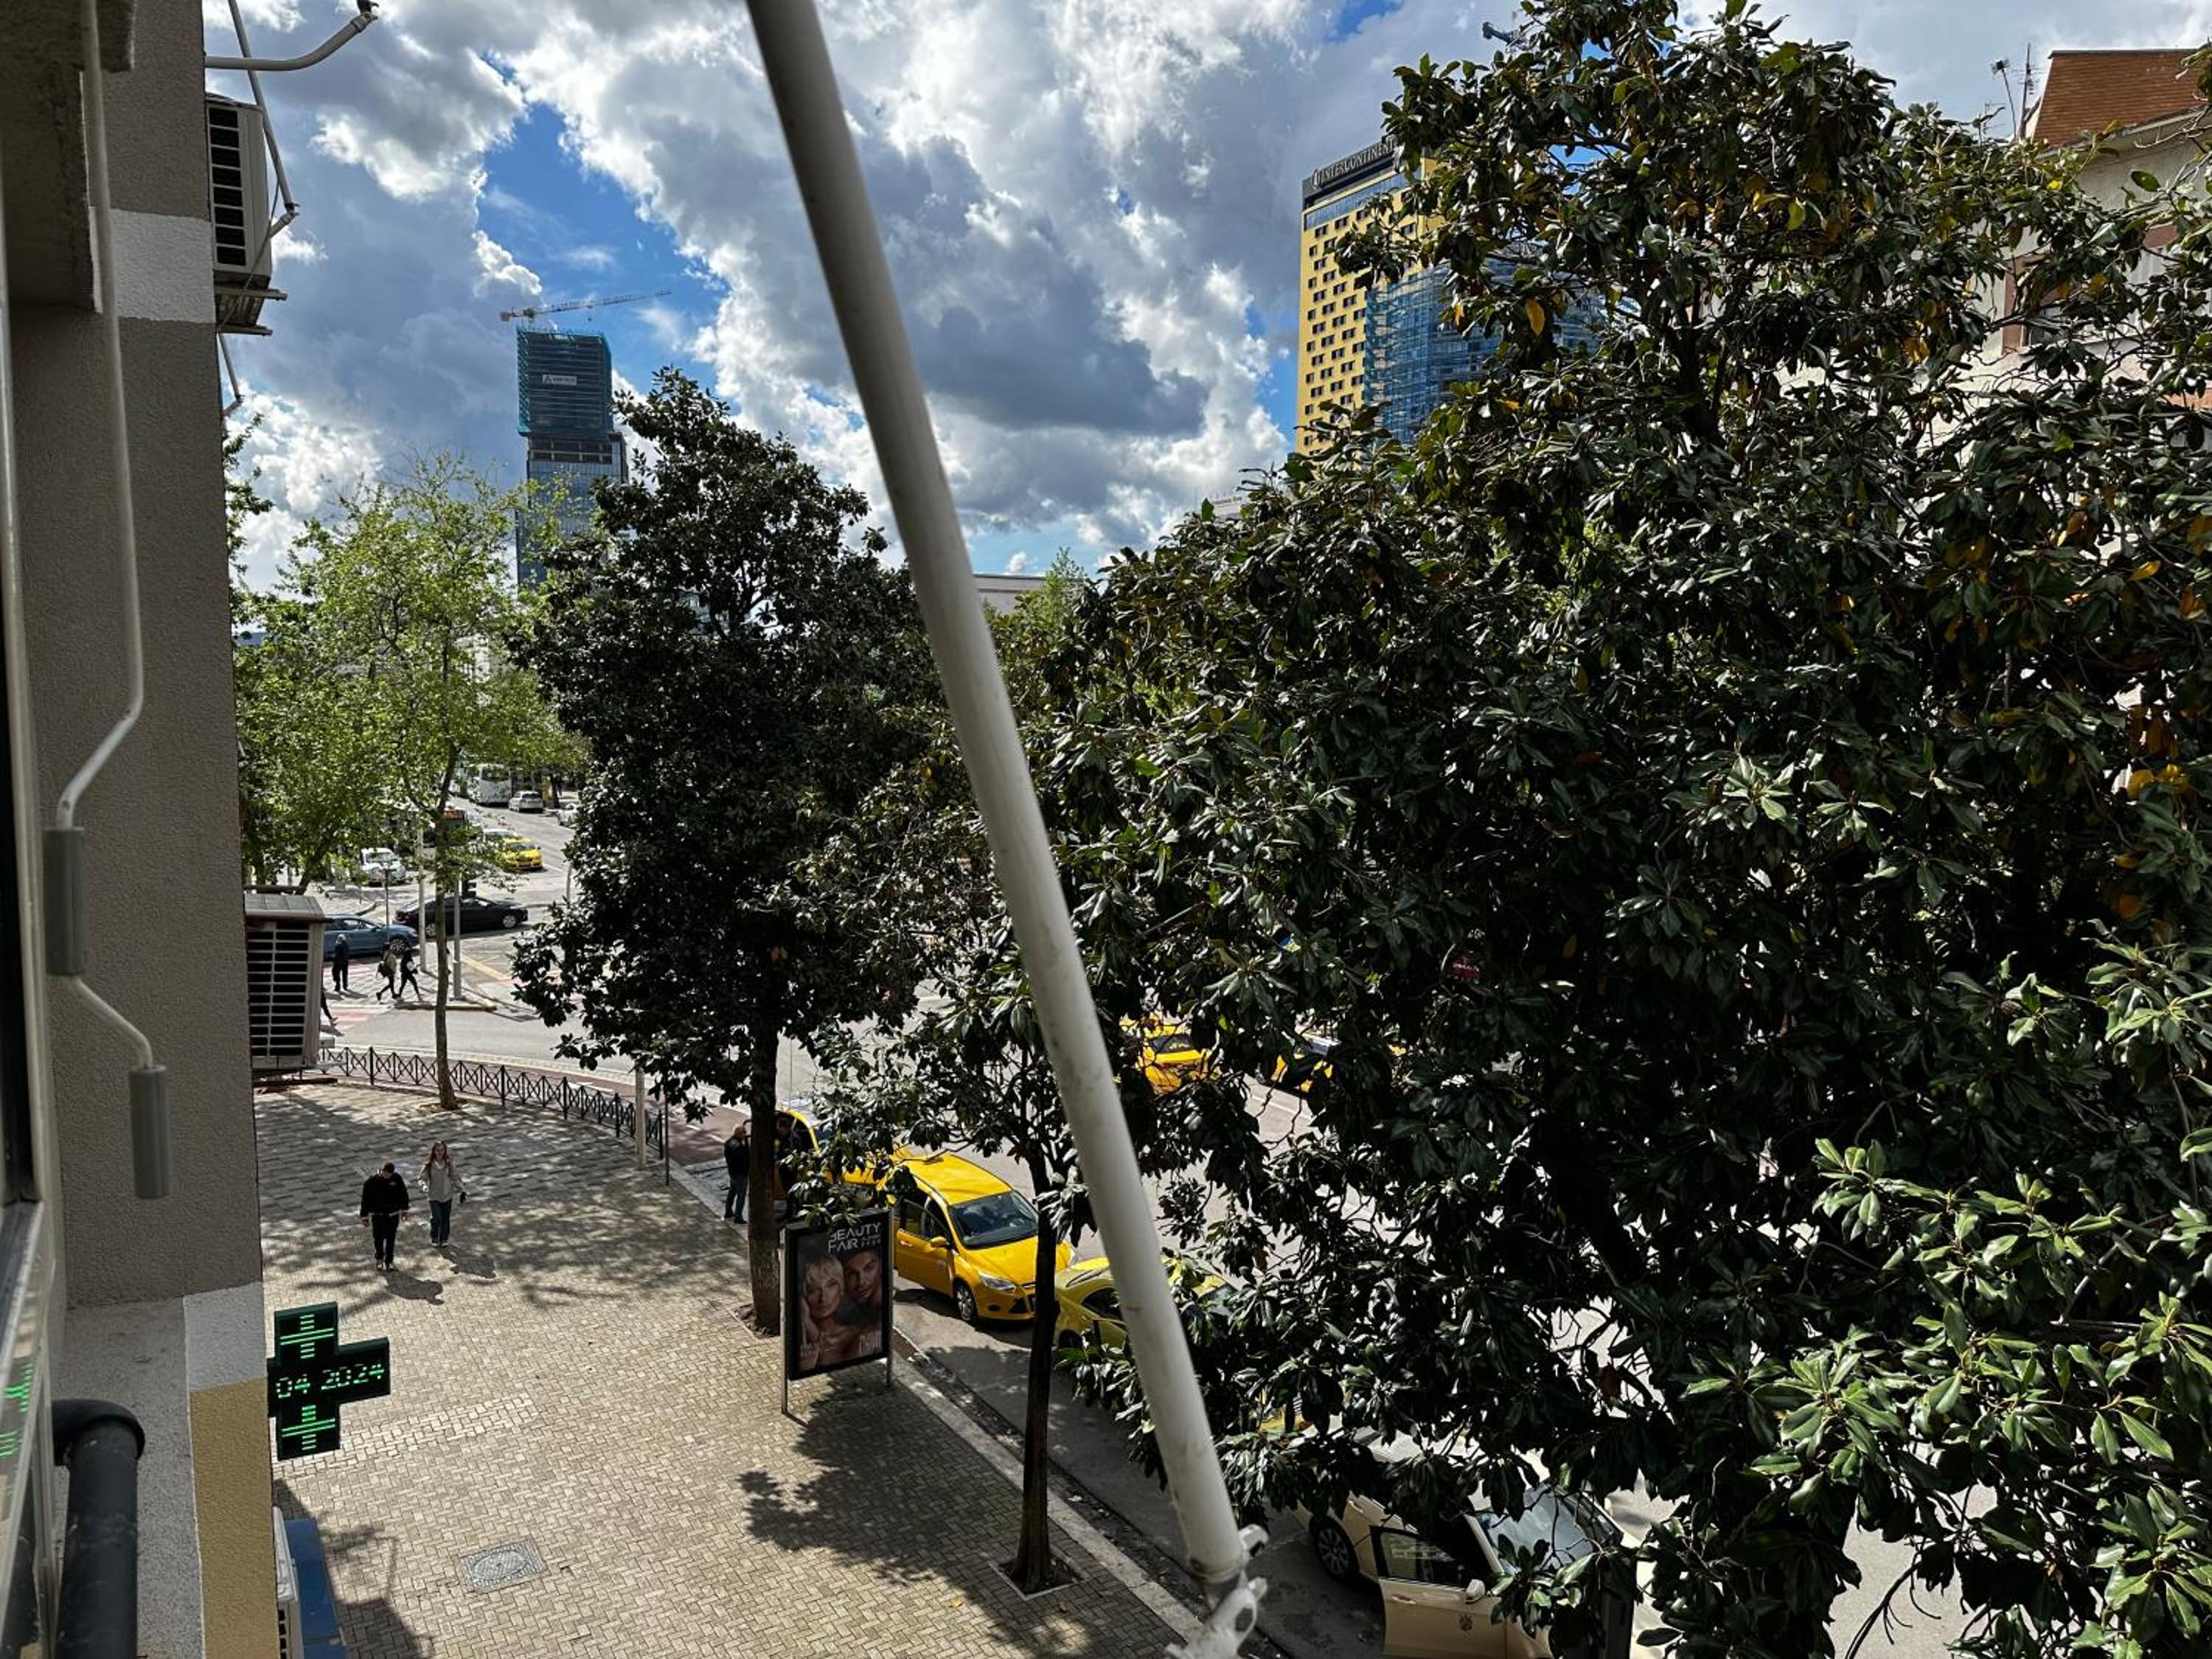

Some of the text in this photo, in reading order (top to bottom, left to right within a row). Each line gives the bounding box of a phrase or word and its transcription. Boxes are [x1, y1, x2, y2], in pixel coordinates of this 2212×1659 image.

[1321, 137, 1394, 184] INTERCONTINENT
[275, 1363, 385, 1399] 04 2024
